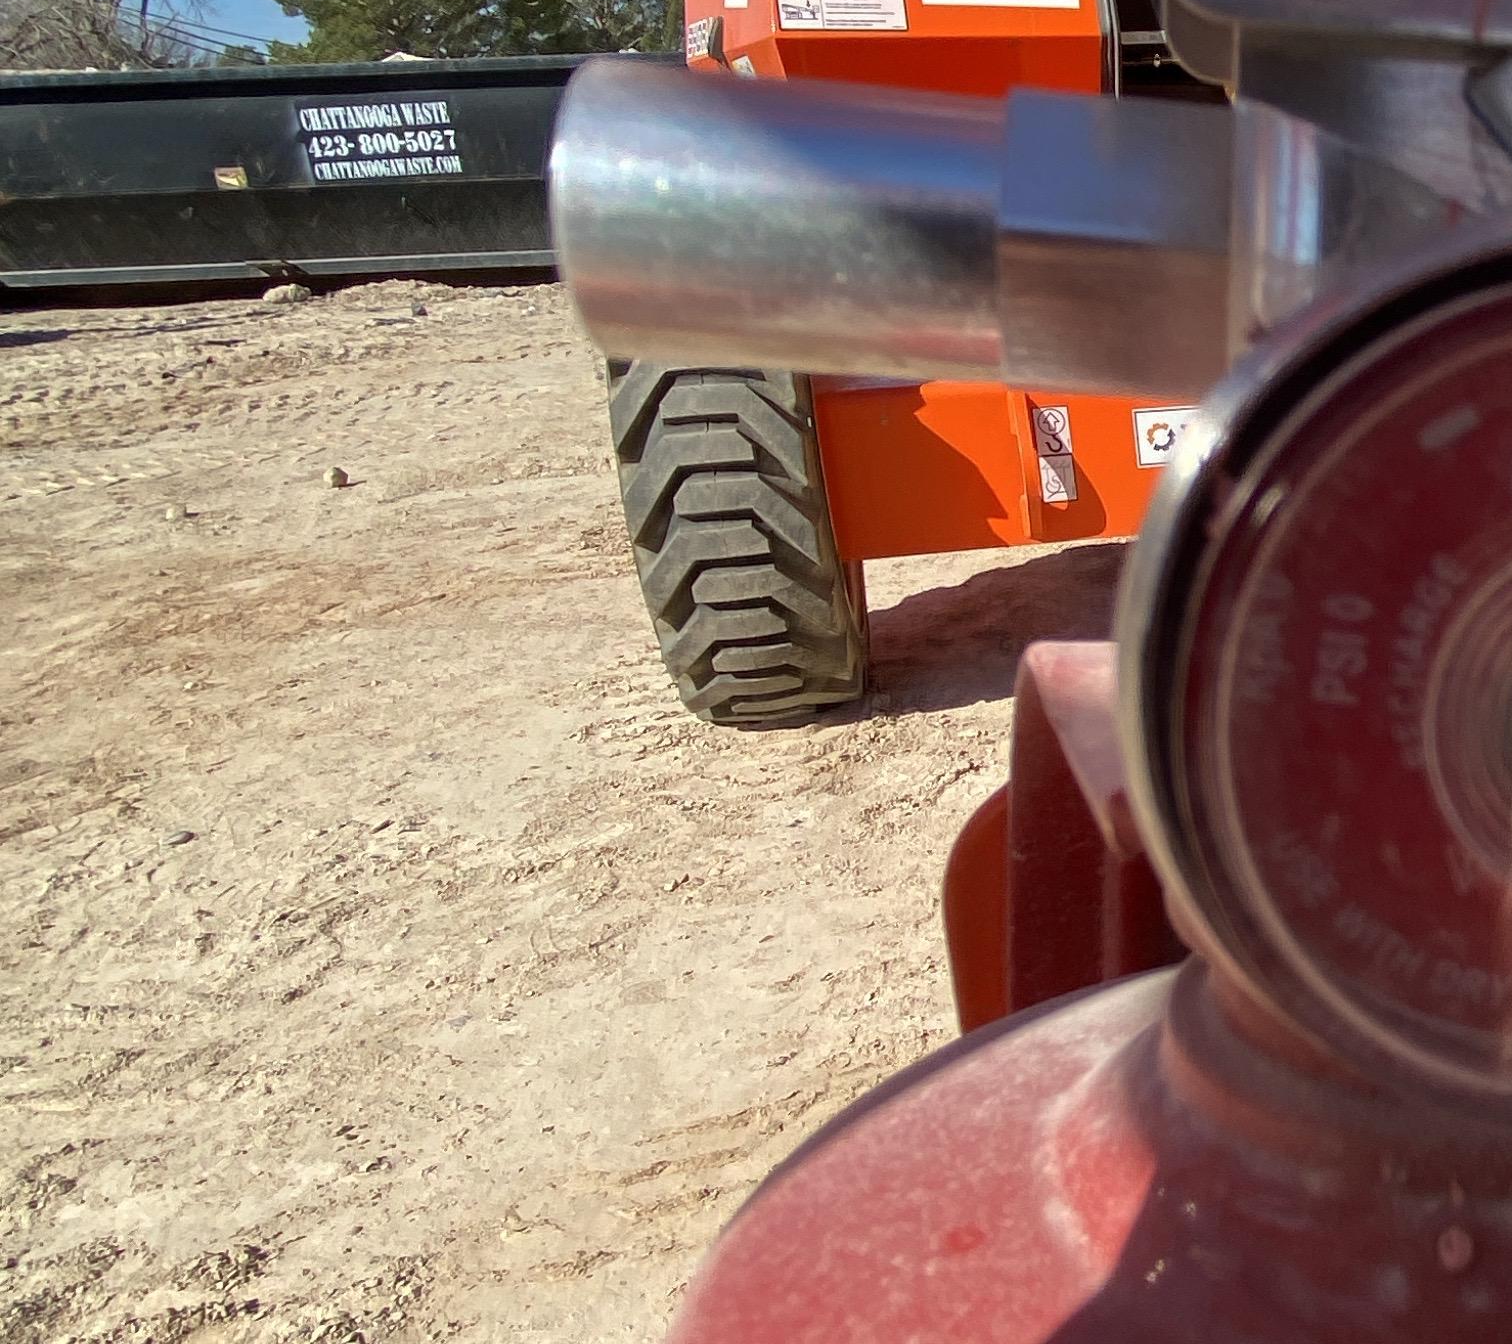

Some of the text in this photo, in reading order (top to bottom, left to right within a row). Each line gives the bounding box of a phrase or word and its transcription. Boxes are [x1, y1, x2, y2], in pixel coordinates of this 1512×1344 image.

[300, 101, 450, 132] CHATTANOOGA WASTE
[314, 155, 463, 182] CHATTANOOGAWASTE.COM
[1311, 629, 1370, 707] PSI
